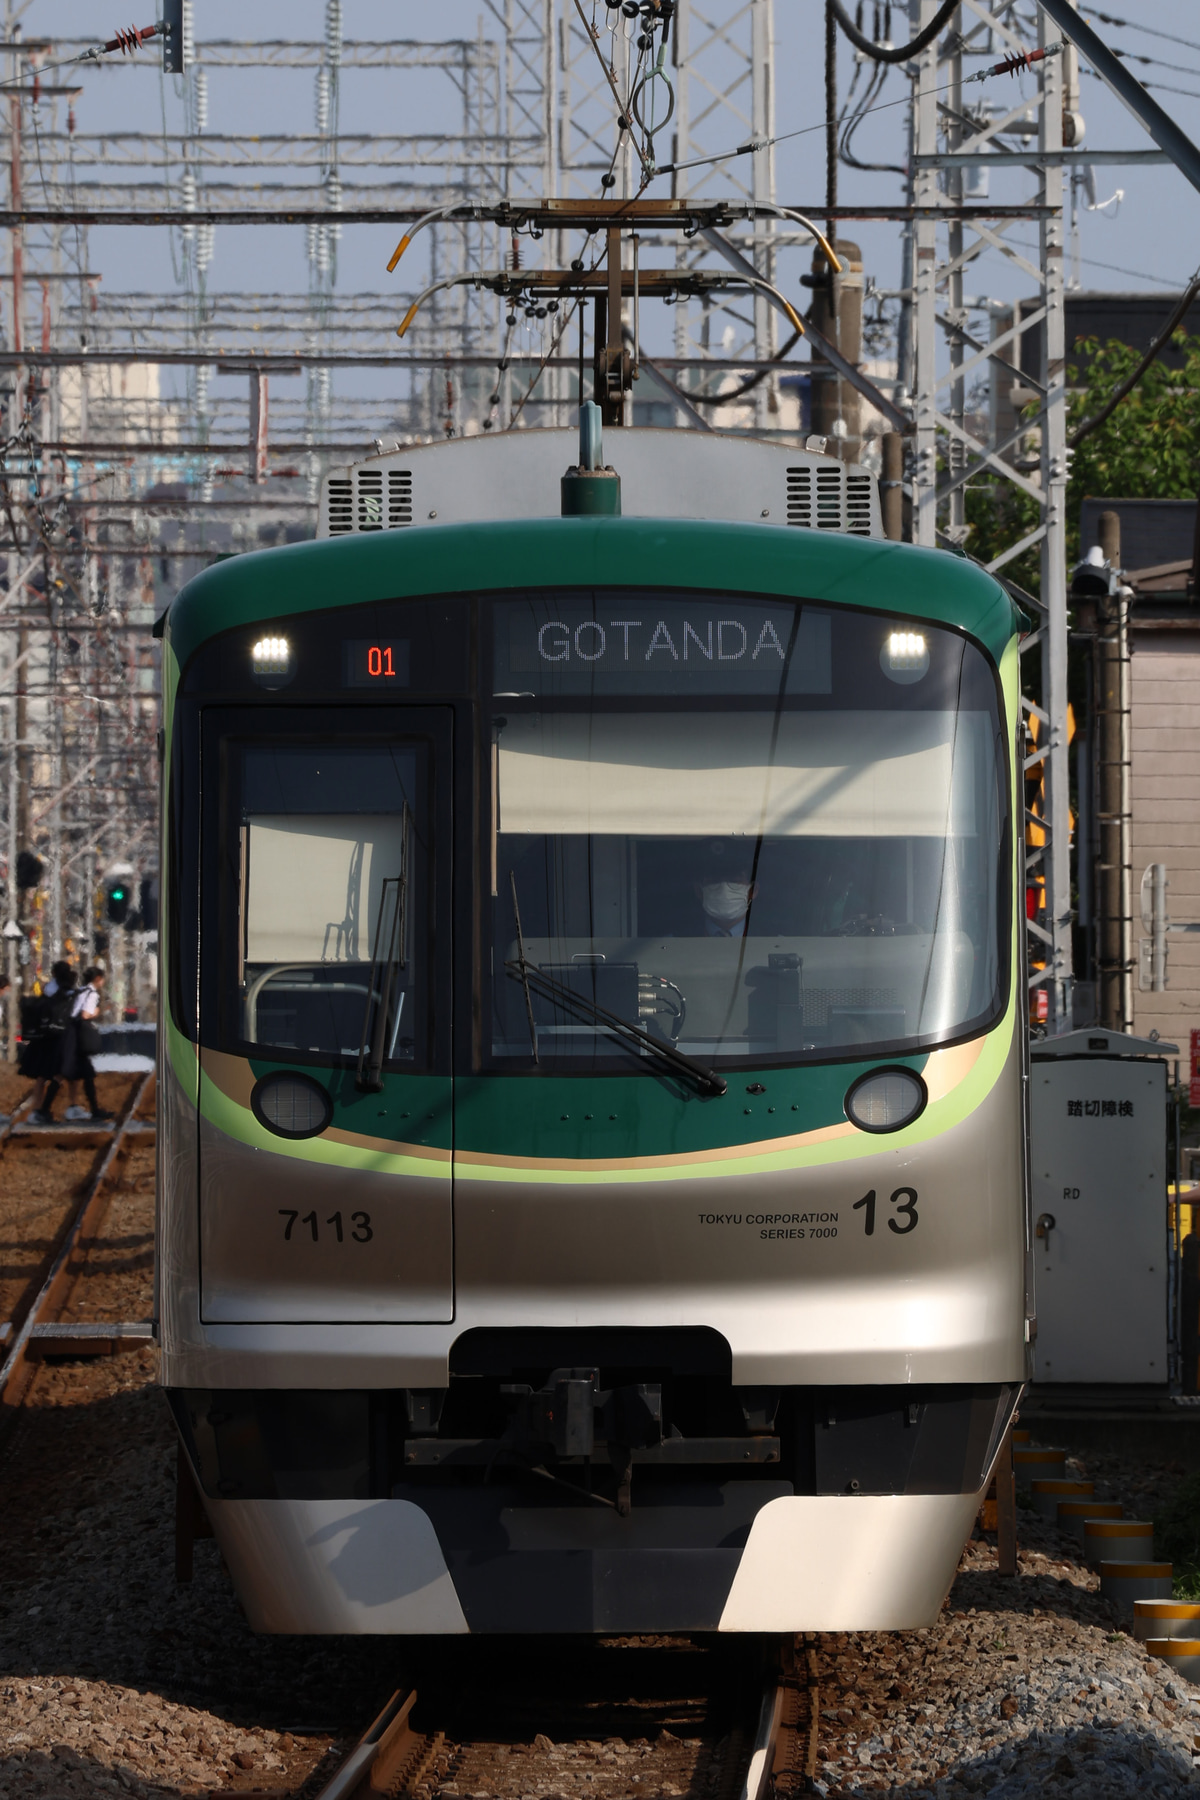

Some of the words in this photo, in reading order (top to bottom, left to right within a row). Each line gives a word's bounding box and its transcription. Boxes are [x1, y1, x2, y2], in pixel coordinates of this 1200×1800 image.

[538, 620, 785, 661] GOTANDA
[368, 646, 396, 676] 01
[1067, 1099, 1134, 1118] 踏切障検
[1063, 1188, 1081, 1200] RD
[698, 1213, 743, 1225] TOKYU
[745, 1212, 839, 1225] CORPORATION
[852, 1186, 919, 1236] 13
[278, 1209, 373, 1243] 7113
[759, 1228, 805, 1240] SERIES
[809, 1227, 838, 1239] 7000
